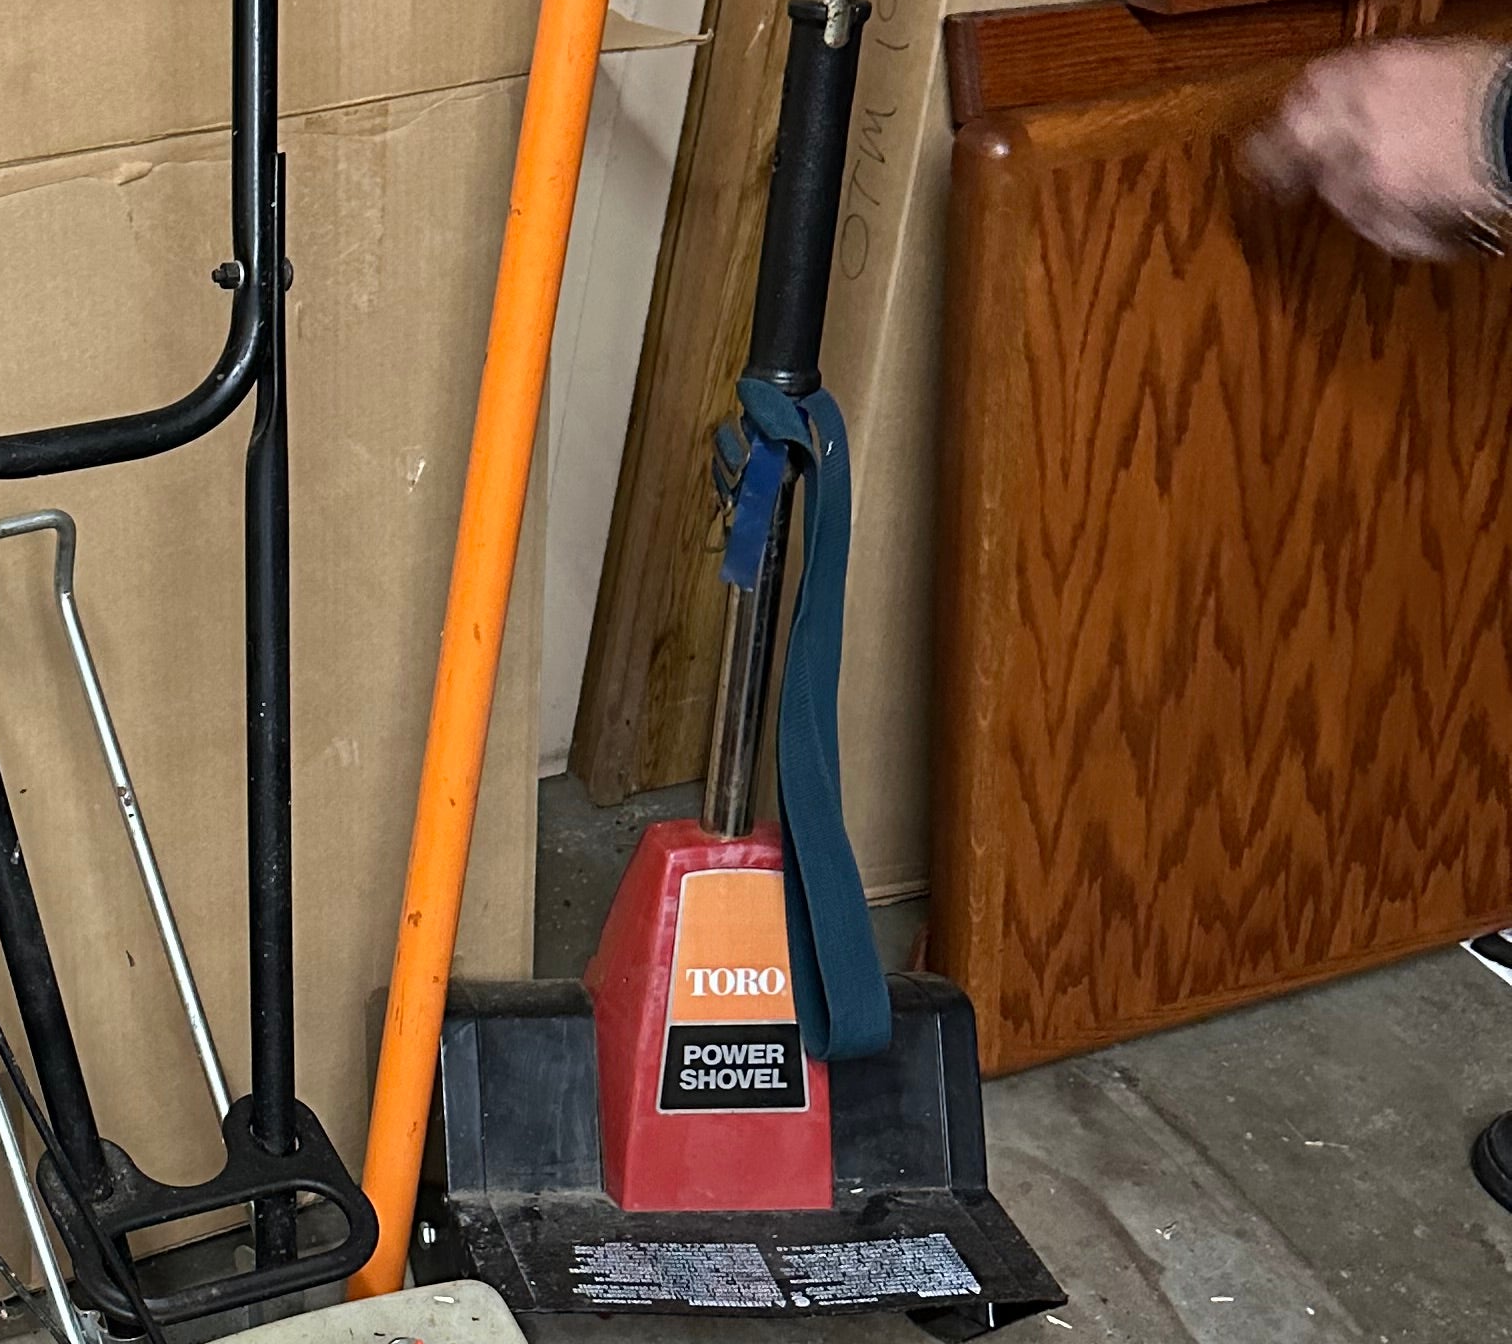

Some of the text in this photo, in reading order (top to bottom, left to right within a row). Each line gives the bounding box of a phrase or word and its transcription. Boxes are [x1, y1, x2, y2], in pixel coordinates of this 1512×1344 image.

[839, 107, 898, 281] OTM
[685, 966, 786, 997] TORO
[683, 1043, 785, 1066] POWER
[679, 1068, 788, 1090] SHOVEL
